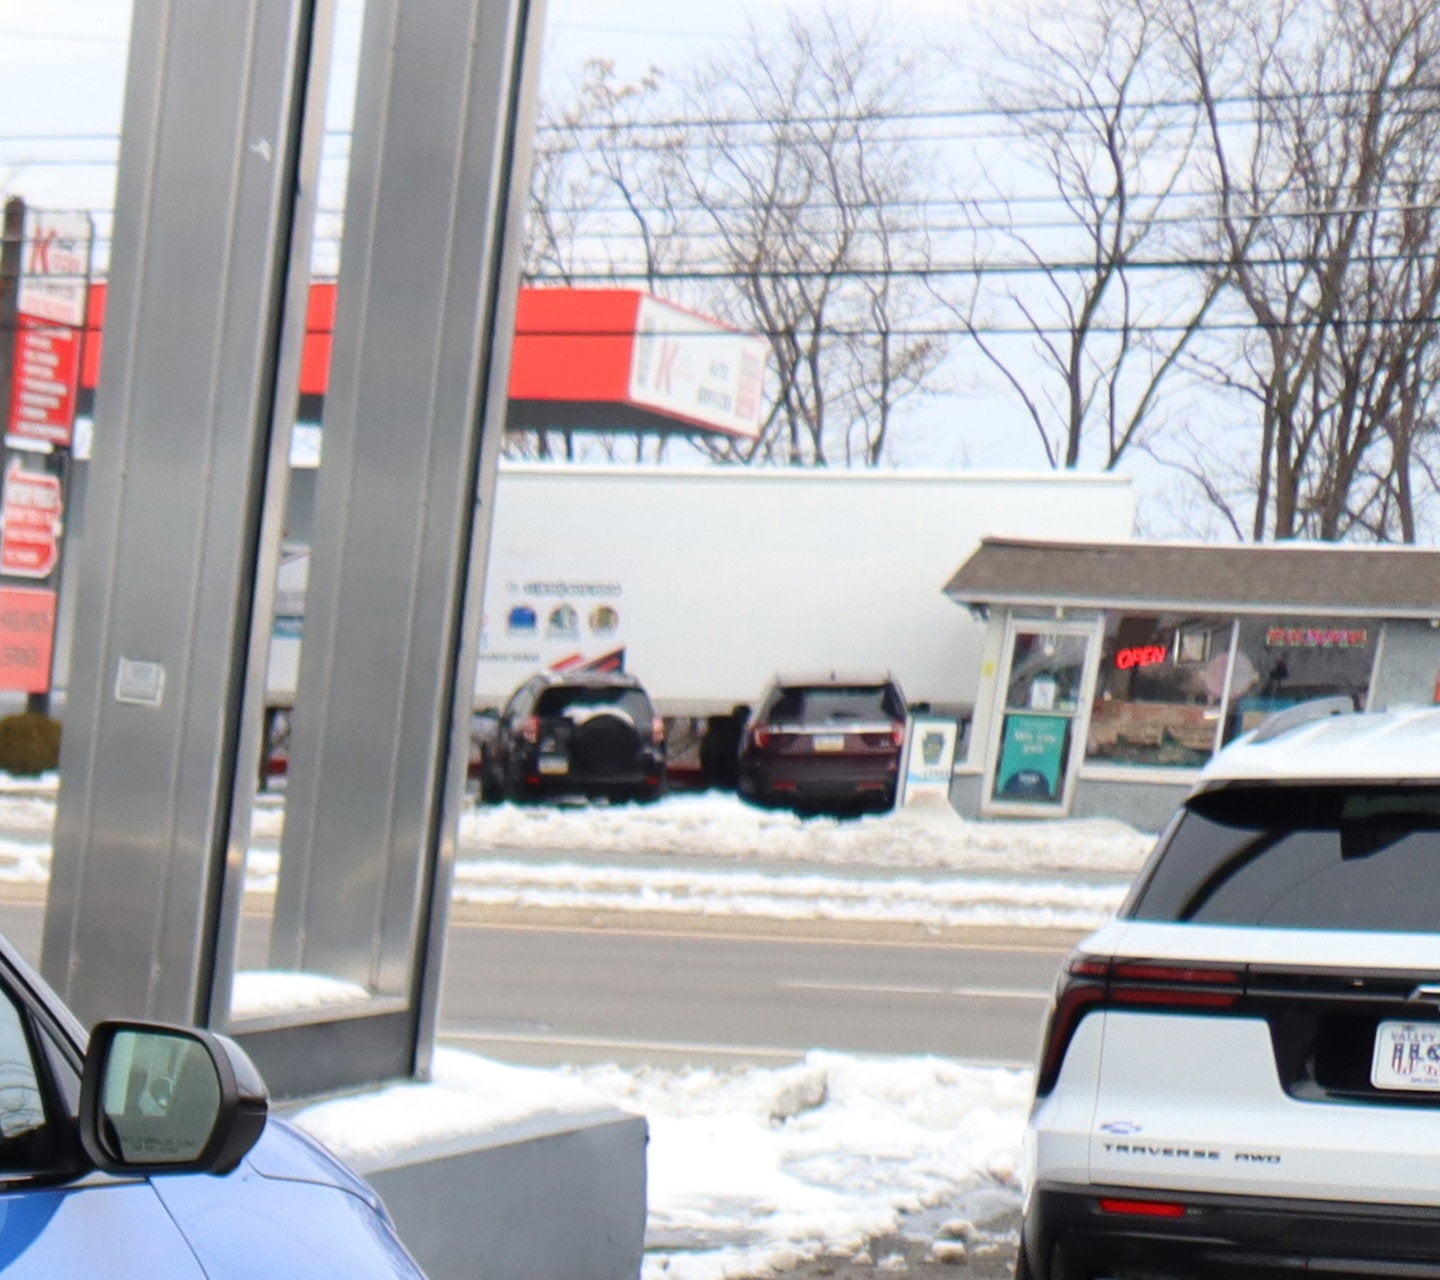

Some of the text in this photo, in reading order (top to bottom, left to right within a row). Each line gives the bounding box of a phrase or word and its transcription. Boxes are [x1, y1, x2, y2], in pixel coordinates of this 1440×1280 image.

[1115, 645, 1167, 670] OPEN
[1104, 1143, 1221, 1160] TRAVERSE
[1234, 1153, 1281, 1164] AWD
